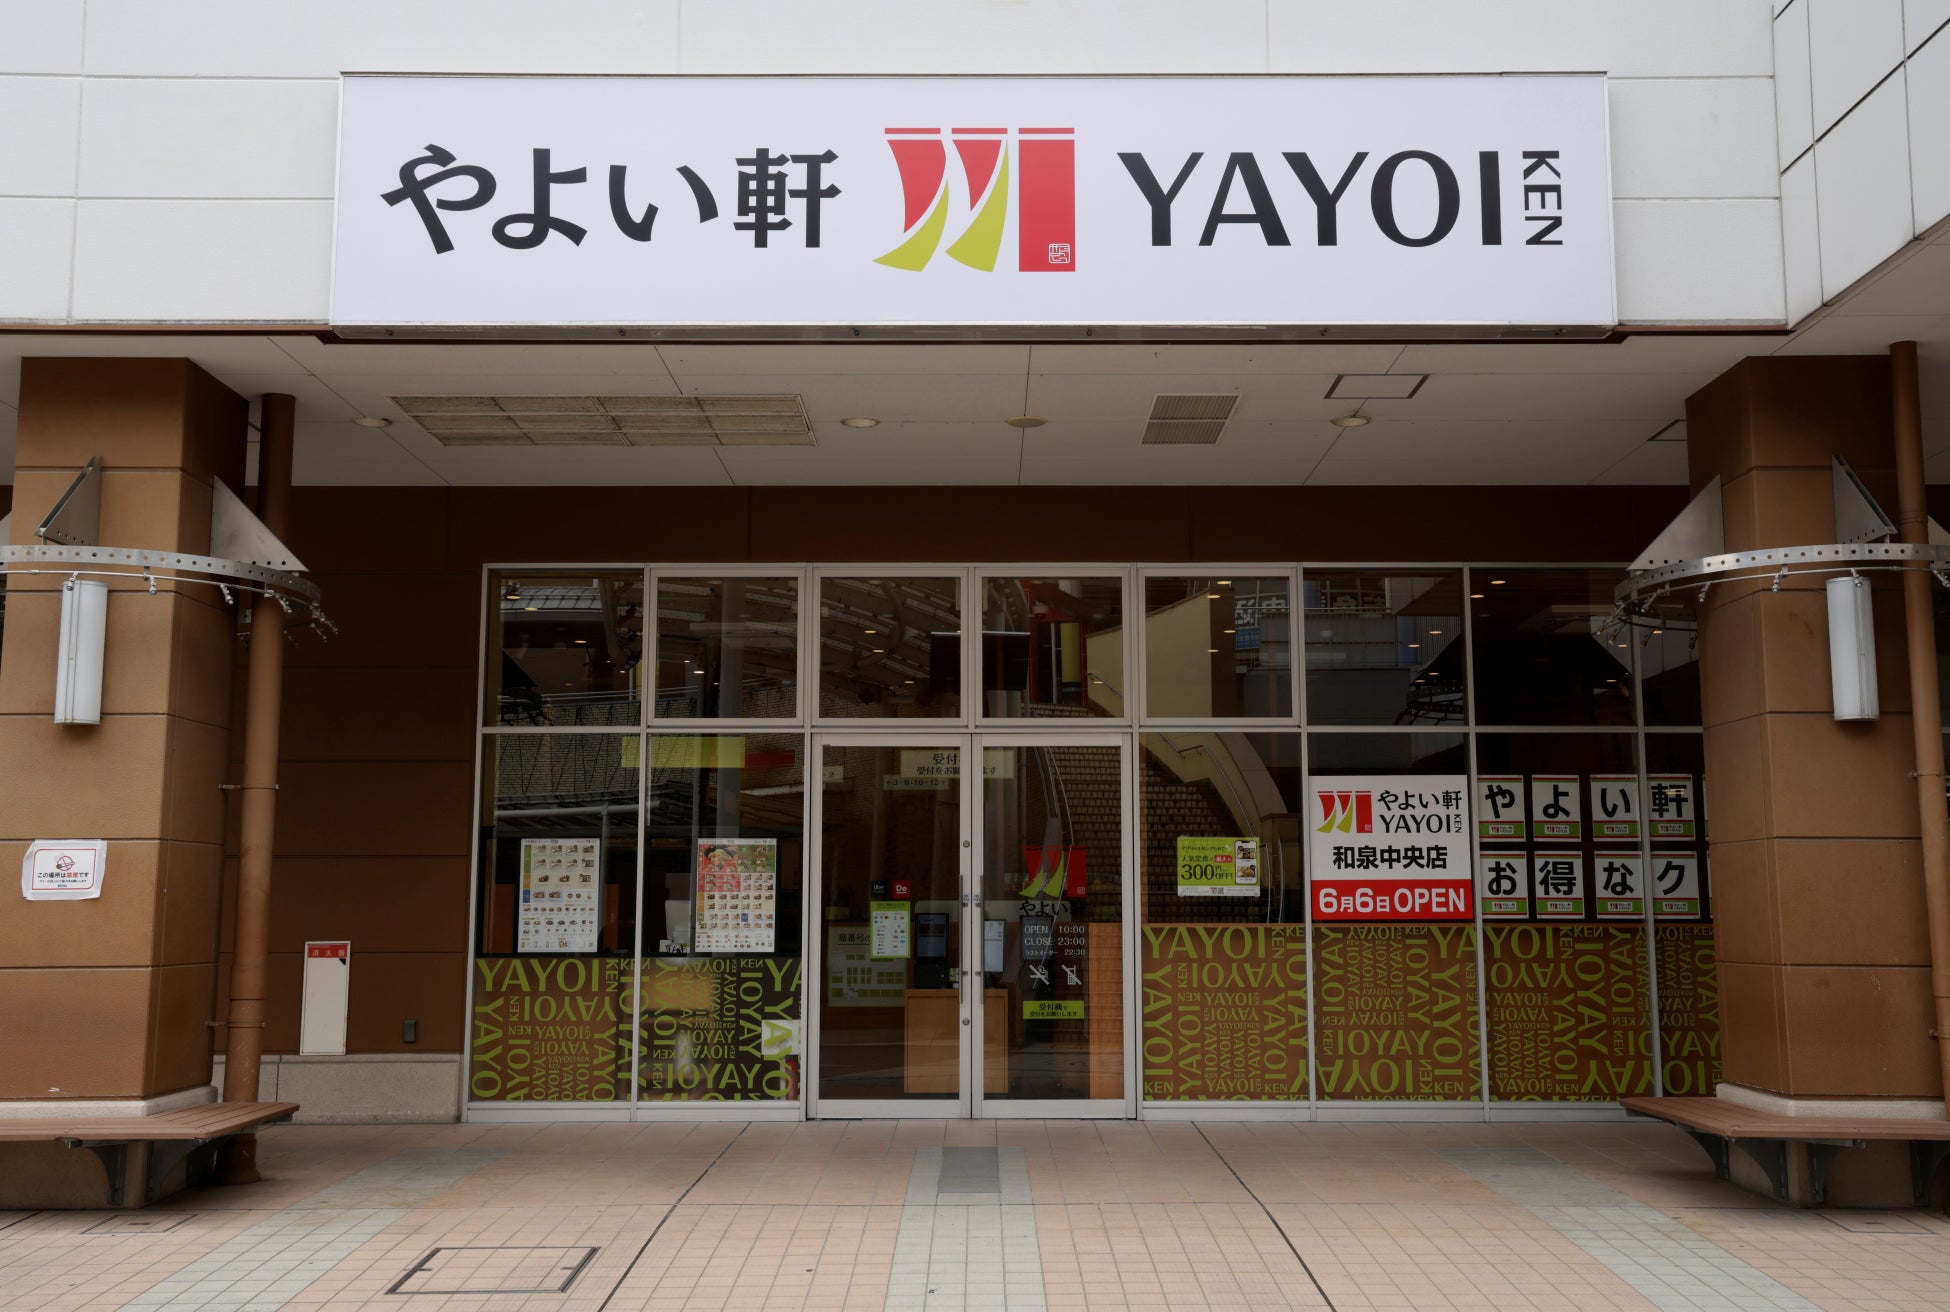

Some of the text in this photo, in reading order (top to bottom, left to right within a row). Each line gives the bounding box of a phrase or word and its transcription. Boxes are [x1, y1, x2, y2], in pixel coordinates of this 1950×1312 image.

[380, 143, 842, 255] やよい軒
[1116, 149, 1564, 248] YAYOI KEN
[932, 752, 960, 765] 受付
[1377, 789, 1462, 811] やよい軒
[1379, 813, 1462, 833] YAYOI KEN
[1333, 845, 1448, 870] 和泉中央店
[1181, 863, 1215, 880] 300
[1319, 887, 1465, 914] 6月6日OPEN
[1024, 925, 1085, 934] OPEN 10:00
[1024, 936, 1085, 946] CLOSE 23:00
[1142, 925, 1285, 959] YAYOI KEN
[1559, 926, 1573, 959] KEN
[1064, 948, 1086, 956] 22:30
[477, 958, 618, 992] YAYOI KEN
[1204, 992, 1252, 1006] YAYOI
[1143, 963, 1173, 1075] YAYOI
[1431, 963, 1464, 1075] YAYOI
[535, 1026, 583, 1039] YAYOI
[1144, 1082, 1174, 1093] KEN
[1206, 1079, 1254, 1092] YAYOI
[1434, 1082, 1464, 1093] KEN
[1496, 1079, 1544, 1092] YAYOI
